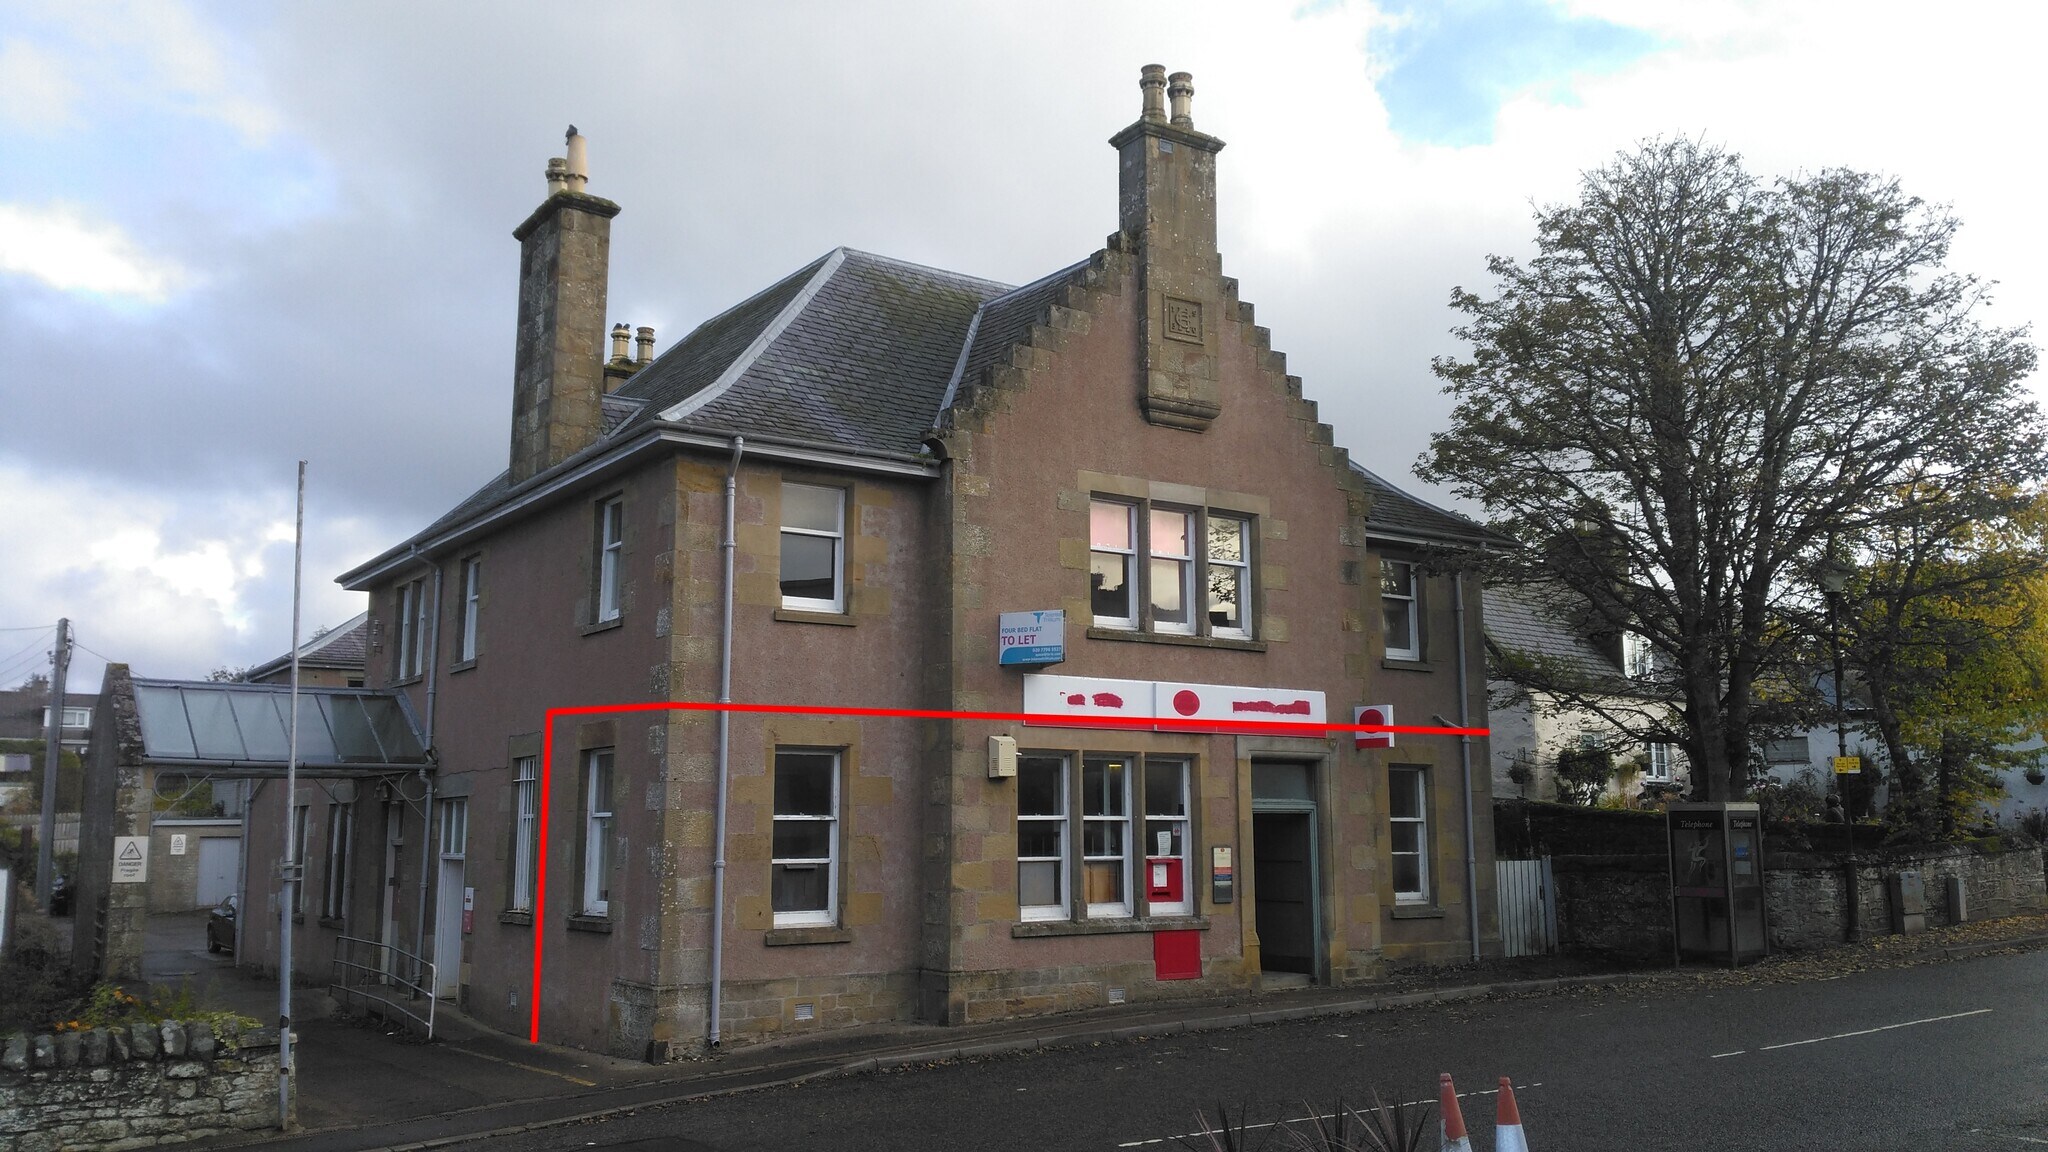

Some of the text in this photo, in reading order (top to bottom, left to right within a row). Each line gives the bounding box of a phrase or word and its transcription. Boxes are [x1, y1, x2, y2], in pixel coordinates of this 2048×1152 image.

[1001, 635, 1036, 645] TO LET
[1680, 820, 1713, 829] Telephone
[1733, 820, 1752, 829] Telephone
